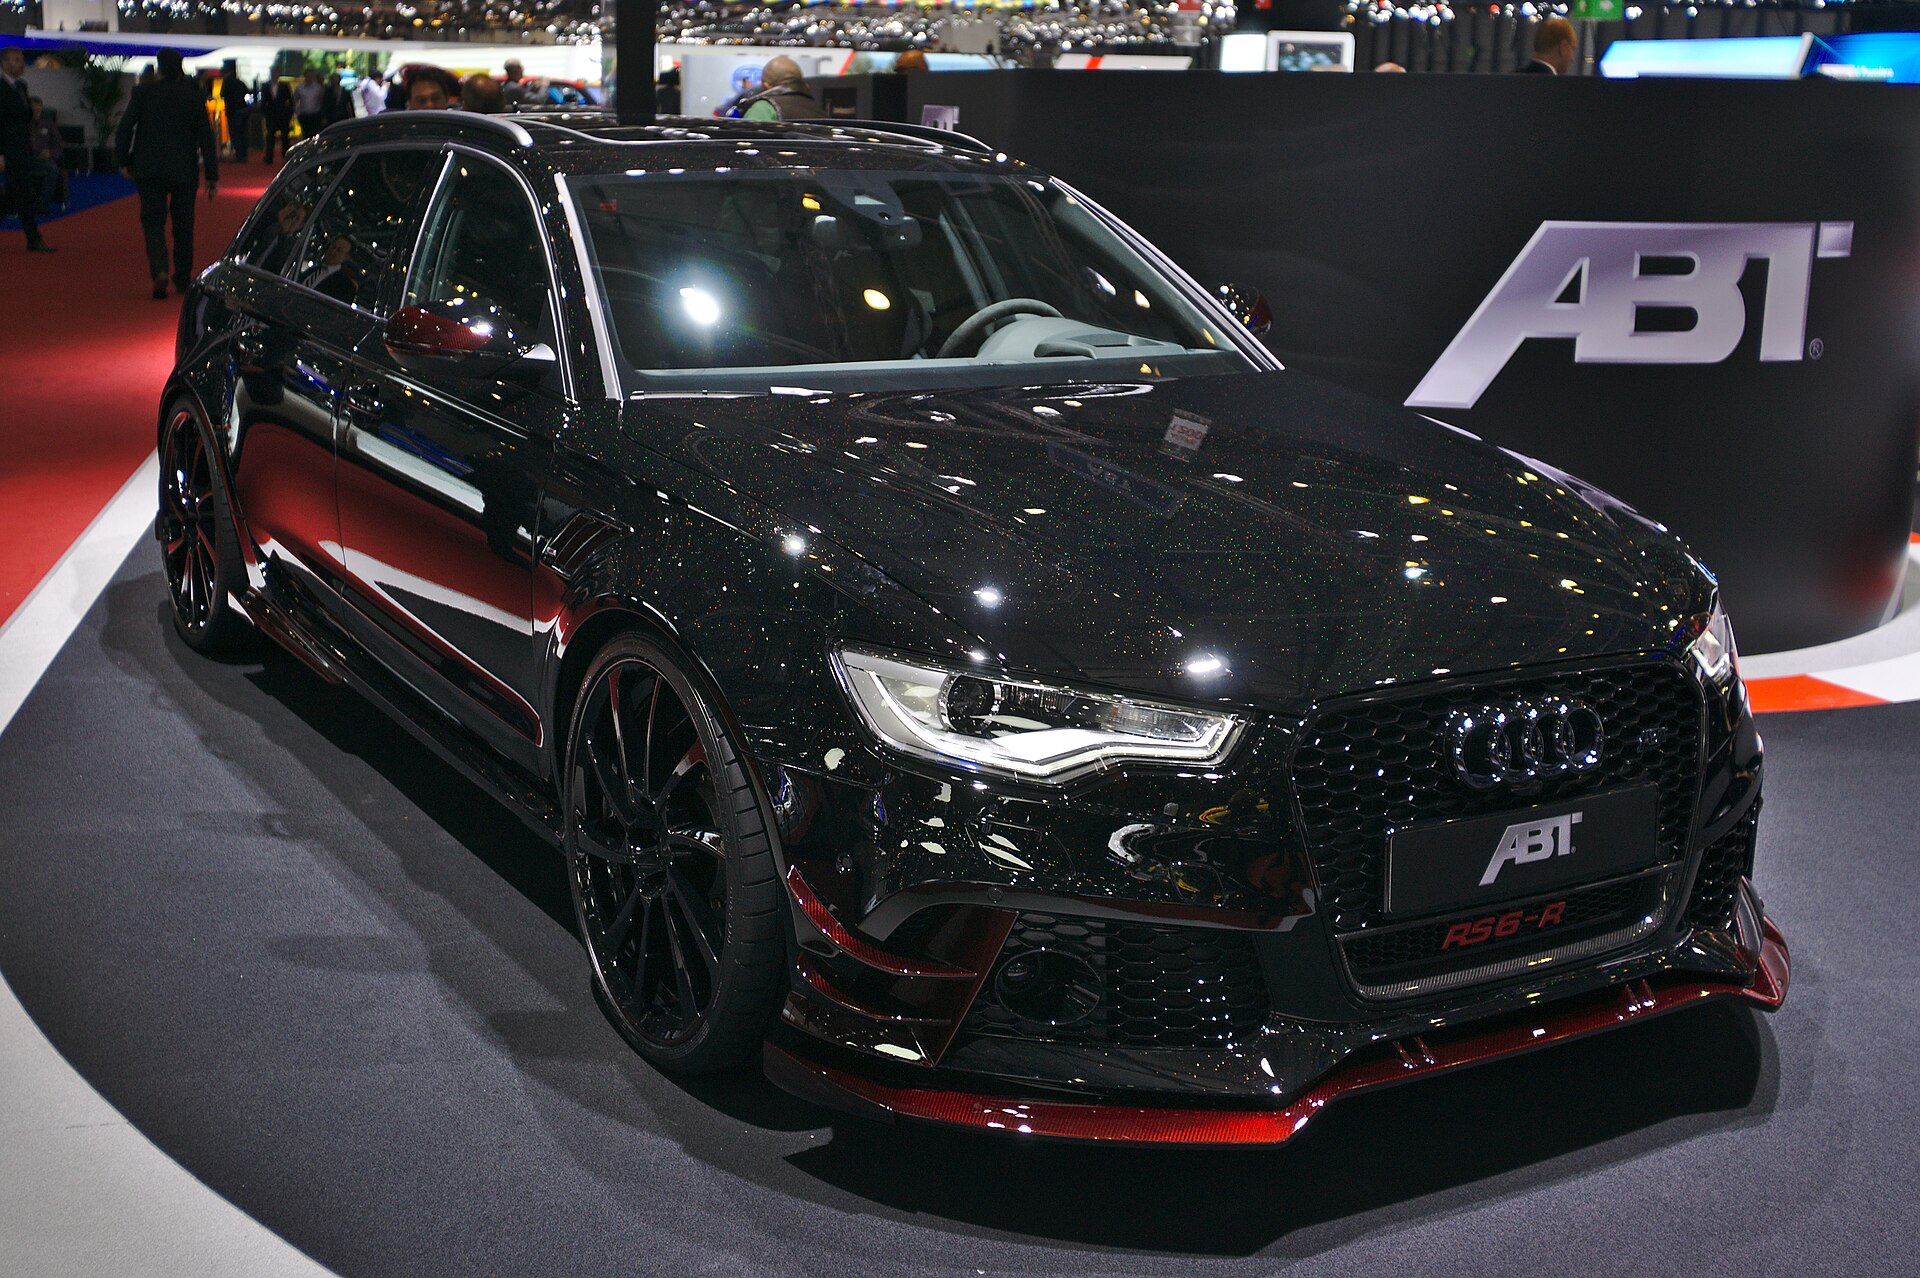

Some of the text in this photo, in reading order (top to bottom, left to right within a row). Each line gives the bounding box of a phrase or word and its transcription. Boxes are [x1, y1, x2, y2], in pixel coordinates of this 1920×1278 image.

[1403, 220, 1854, 409] ABT
[1478, 811, 1583, 887] ABT
[1441, 901, 1566, 951] RS6-R
